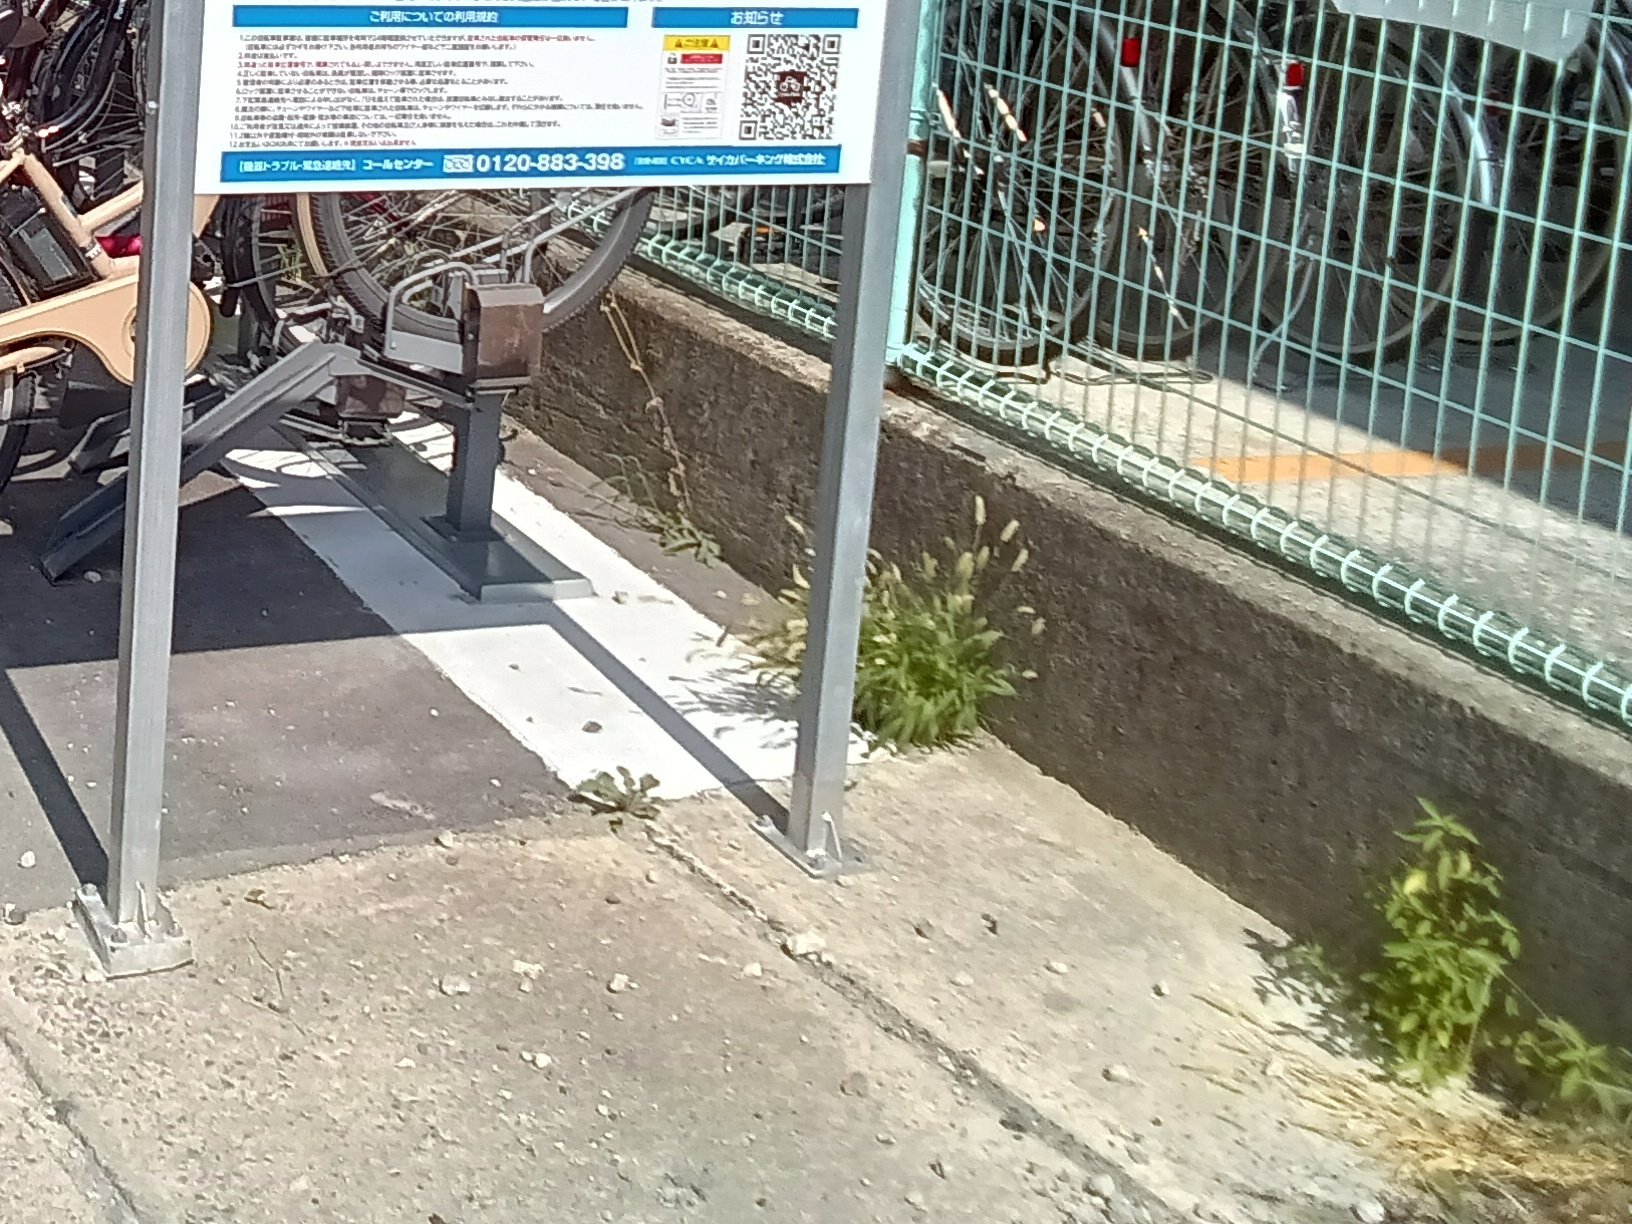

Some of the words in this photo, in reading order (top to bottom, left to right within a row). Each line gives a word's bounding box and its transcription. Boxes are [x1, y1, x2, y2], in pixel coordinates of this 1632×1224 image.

[731, 11, 784, 25] お知らせ
[362, 158, 434, 171] コールセンター
[477, 153, 625, 172] 0120-883-398
